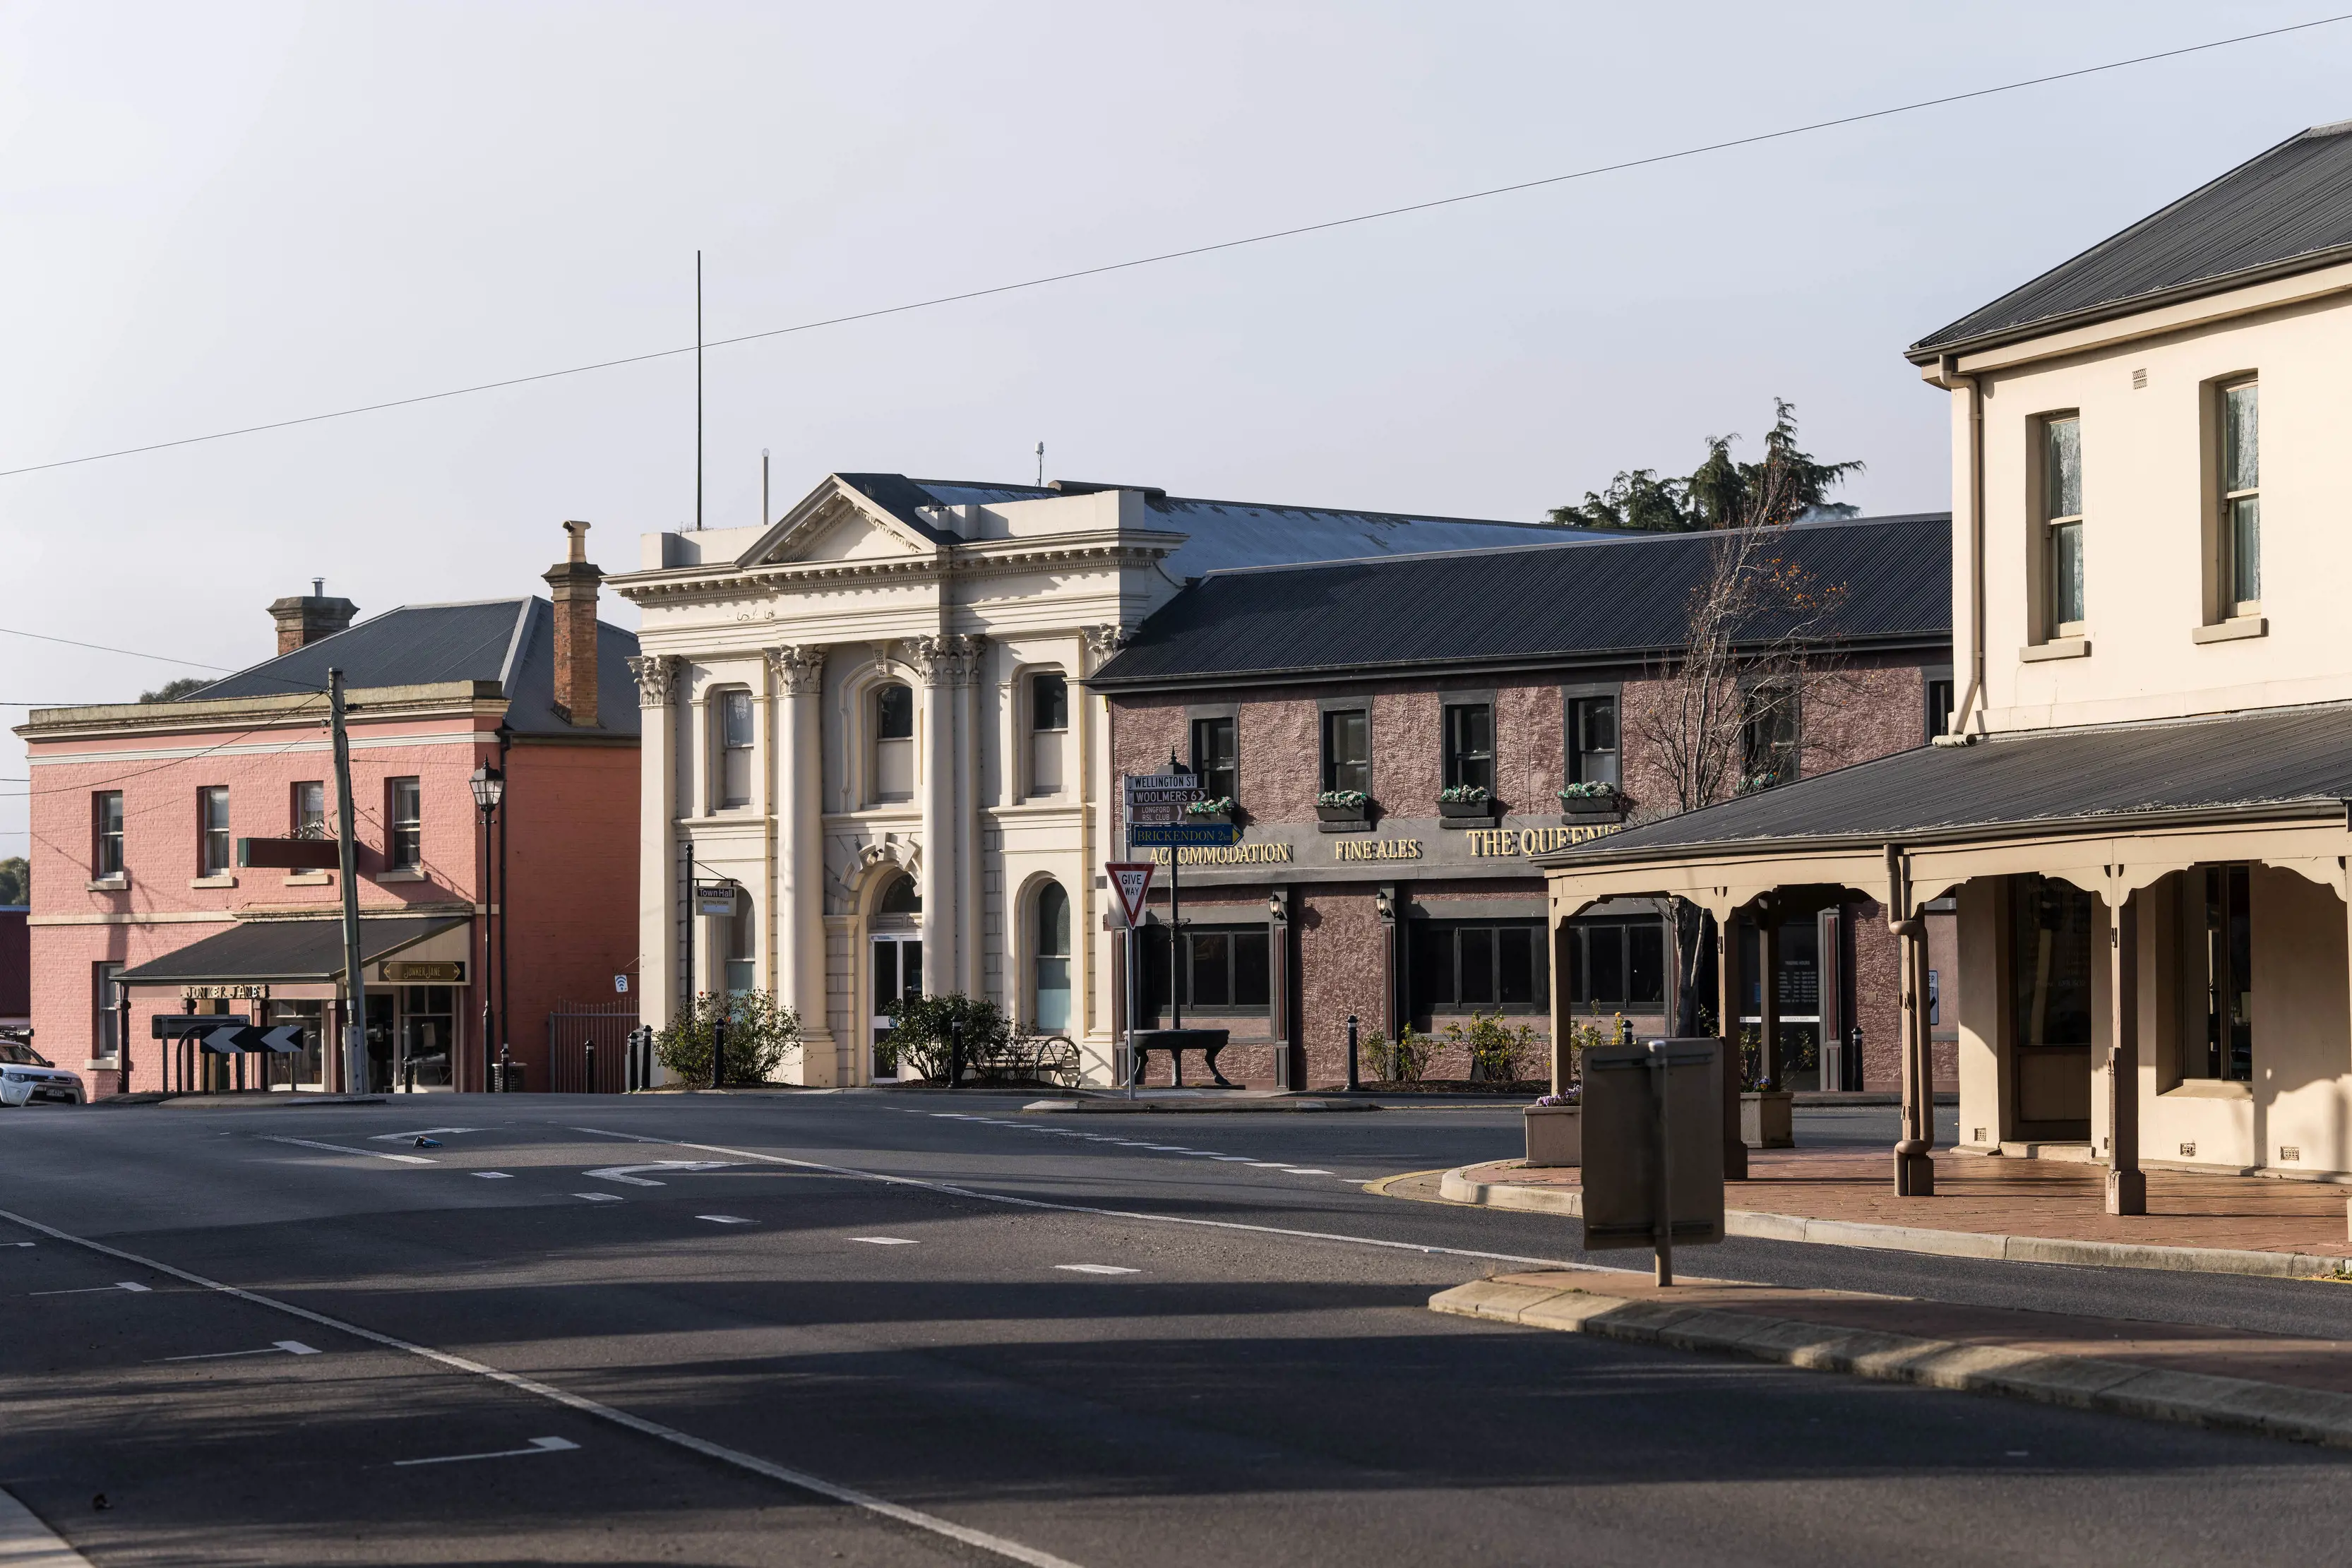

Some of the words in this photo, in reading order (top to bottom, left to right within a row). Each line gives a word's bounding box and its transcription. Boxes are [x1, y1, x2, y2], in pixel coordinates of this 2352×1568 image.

[1135, 776, 1184, 788] WELLINGTON
[1186, 776, 1195, 786] ST
[1136, 790, 1188, 803] WOOLMERS
[1190, 790, 1197, 801] 6
[1137, 830, 1214, 842] BRICKENDON
[1217, 830, 1231, 842] 2km
[1466, 829, 1514, 856] THE
[1335, 840, 1373, 859] FINE
[1375, 839, 1418, 858] ALES
[1121, 874, 1142, 885] GIVE
[698, 888, 717, 897] Town
[719, 889, 732, 897] Hall
[1125, 887, 1140, 896] WAY
[404, 965, 425, 979] JUNKER
[425, 965, 441, 979] JANE
[186, 986, 227, 999] JUNKER
[230, 984, 259, 999] JANE
